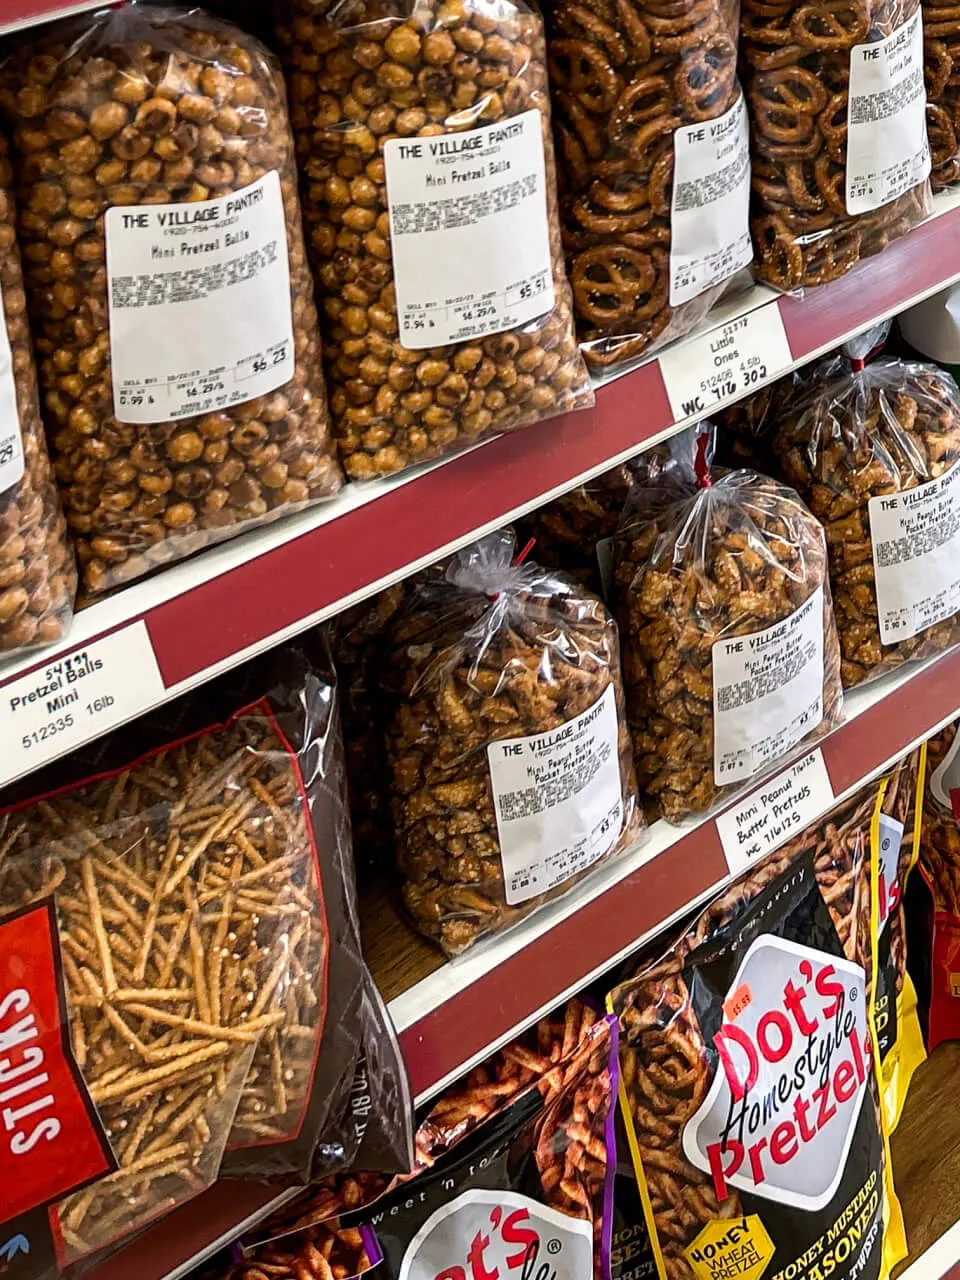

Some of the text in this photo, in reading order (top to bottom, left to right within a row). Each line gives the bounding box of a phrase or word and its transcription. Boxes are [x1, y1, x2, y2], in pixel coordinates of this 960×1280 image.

[398, 122, 524, 159] THE VILLAGE PANTRY
[121, 187, 263, 229] THE VILLAGE PANTRY
[181, 239, 220, 256] Pretzel
[710, 336, 734, 352] Little
[714, 349, 739, 366] Ones
[682, 397, 705, 415] WC
[744, 365, 767, 386] 302
[9, 657, 104, 712] Pretzel Balls
[46, 689, 79, 714] Mini
[21, 693, 115, 749] 512335 16lb
[503, 701, 605, 757] THE VILLAGE PANTRY
[735, 779, 792, 826] Mini Peanut
[737, 786, 811, 844] Butter Pretzels
[712, 959, 844, 1102] Dot's
[719, 988, 858, 1152] Homestyle
[826, 1170, 876, 1245] MUSTARD
[691, 1218, 750, 1263] HONEY
[705, 1238, 756, 1271] WHEAT
[711, 1252, 764, 1280] PRETZEL
